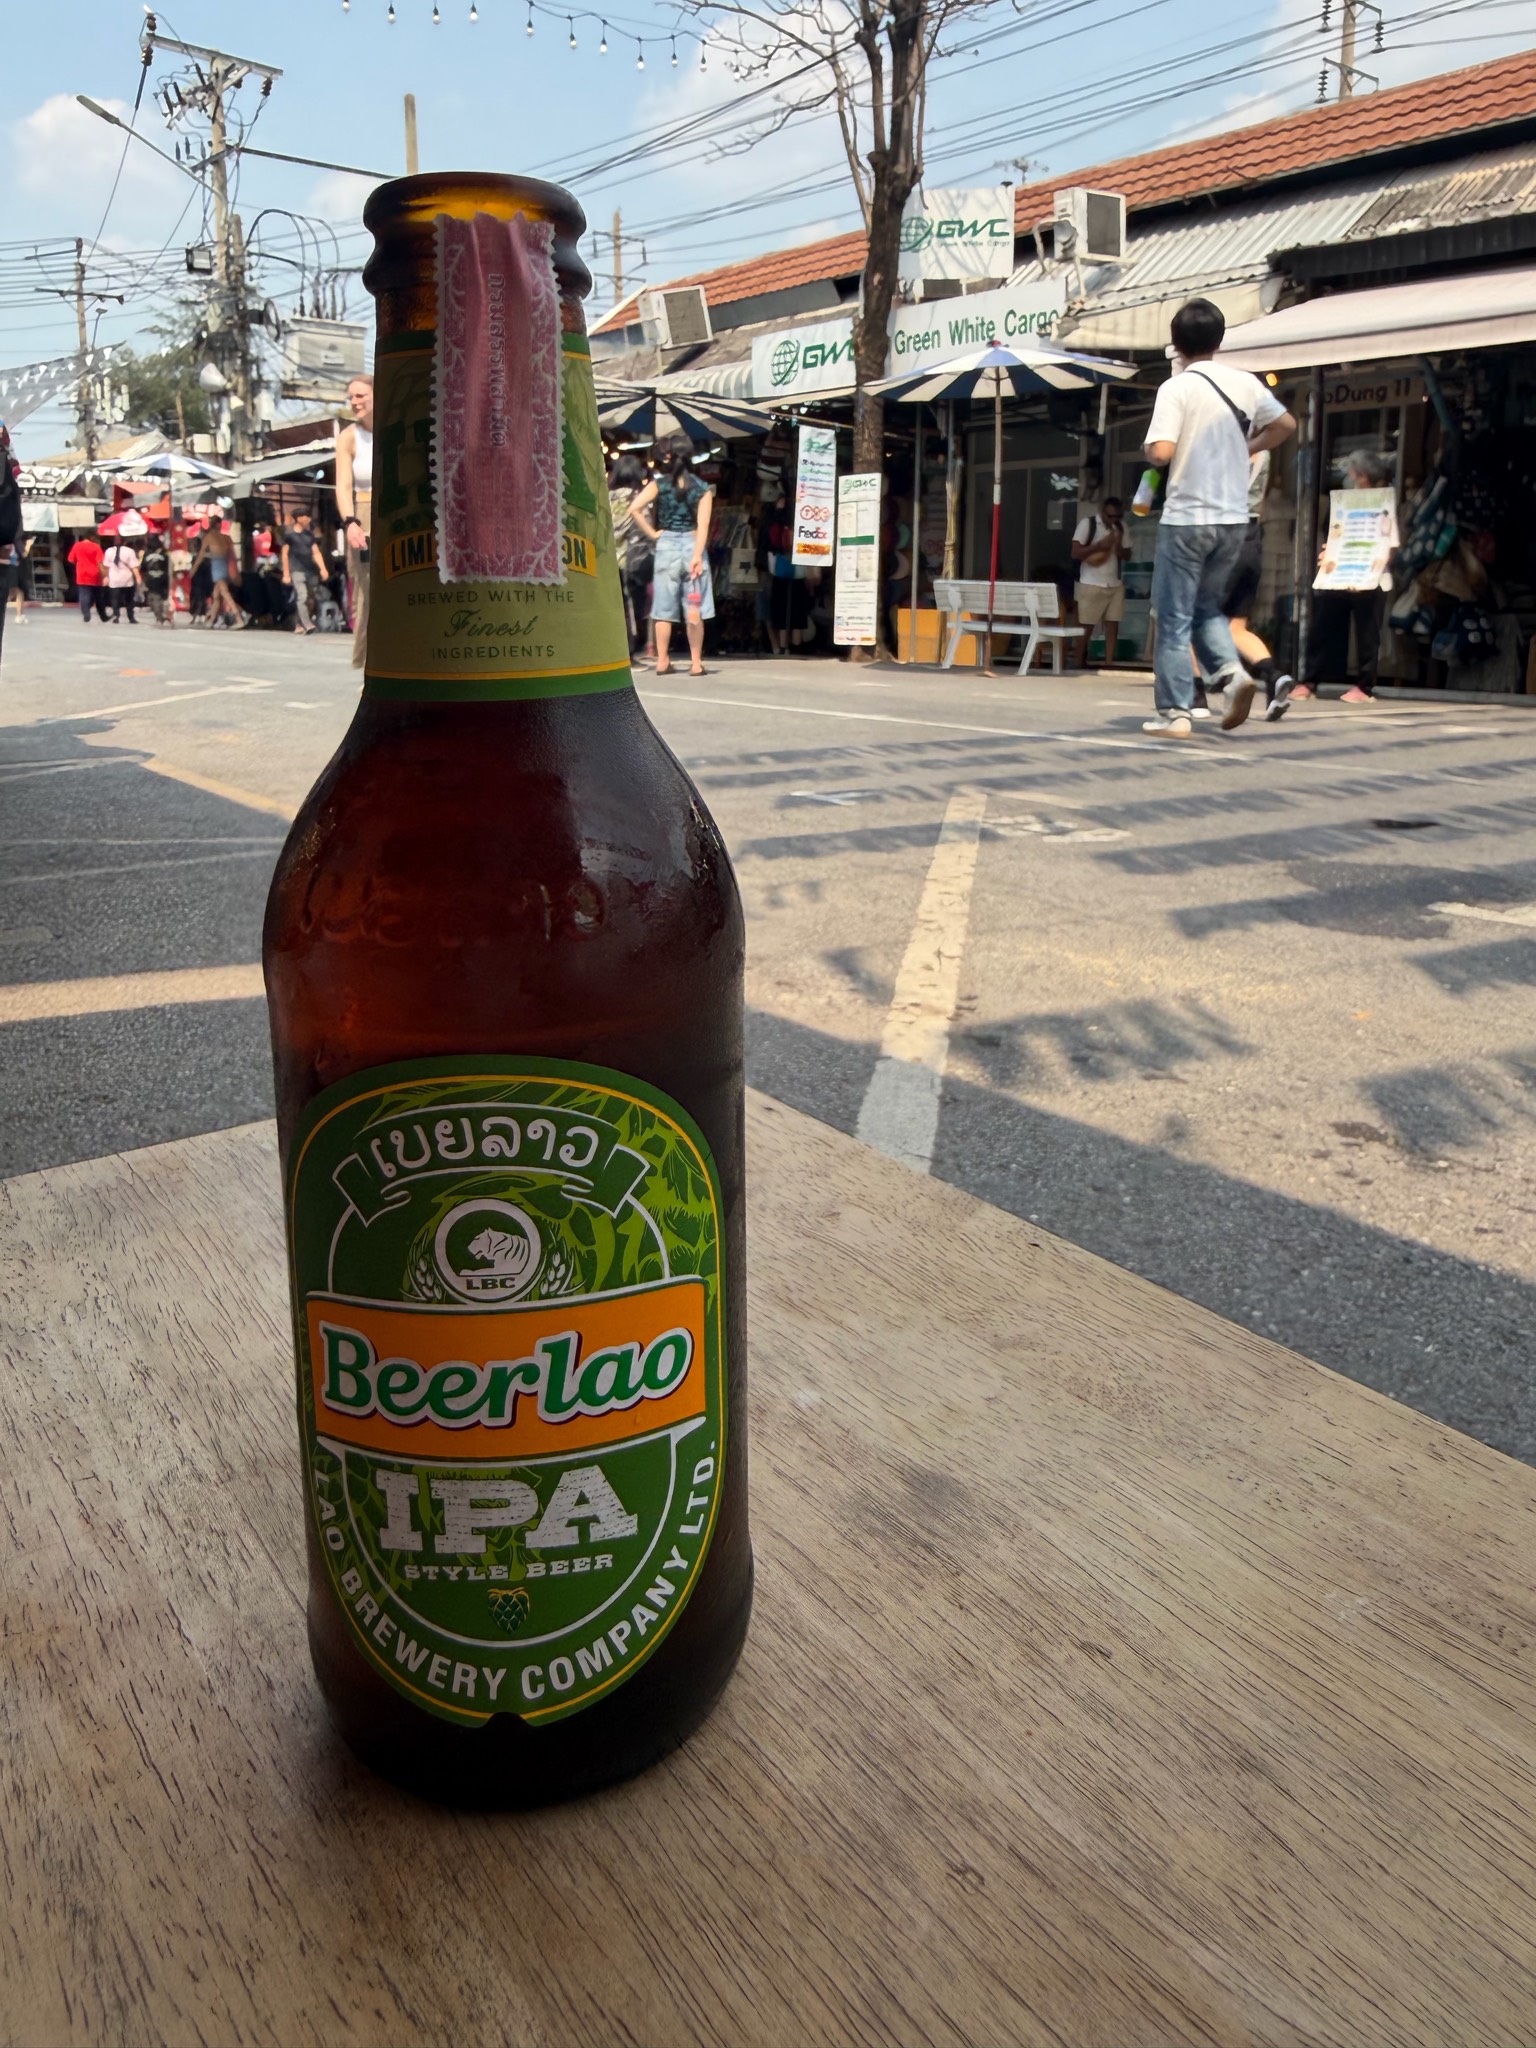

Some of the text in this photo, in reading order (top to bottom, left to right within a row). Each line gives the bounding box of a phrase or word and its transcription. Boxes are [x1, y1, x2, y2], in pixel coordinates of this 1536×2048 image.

[936, 218, 1010, 238] GWC
[894, 308, 1060, 356] Green White Cargo
[390, 535, 434, 572] LIMI
[407, 589, 575, 606] BREWED WITH THE
[444, 608, 539, 638] Finest
[431, 644, 556, 660] INGREDIENTS
[370, 1115, 600, 1178] ເບຍລາວ
[466, 1277, 516, 1290] LBC
[318, 1321, 695, 1430] Beerlao
[374, 1464, 640, 1555] IPA
[314, 1440, 716, 1701] LAO BREWERY COMPANY LTD.
[404, 1553, 614, 1582] STYLE BEER
